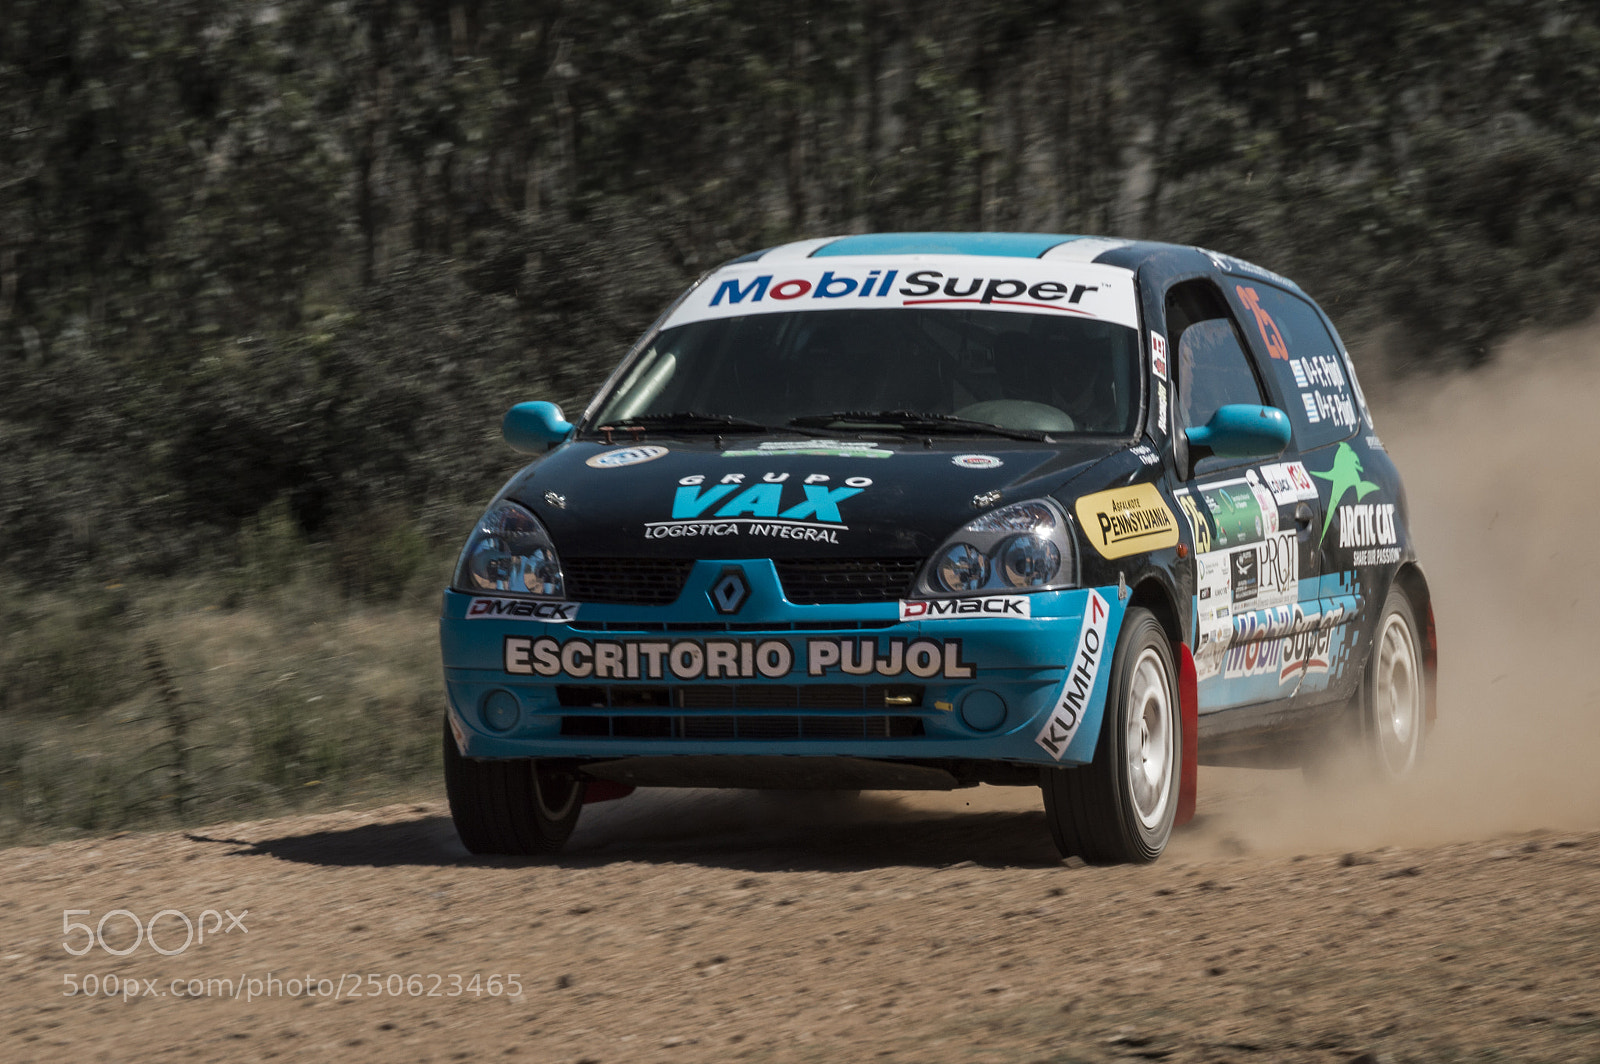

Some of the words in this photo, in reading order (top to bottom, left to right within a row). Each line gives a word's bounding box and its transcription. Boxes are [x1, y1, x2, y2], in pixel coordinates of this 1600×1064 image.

[1236, 285, 1289, 361] 25
[678, 472, 873, 487] GRUPO
[671, 483, 865, 523] VAX
[644, 522, 740, 540] LOGISTICA
[748, 523, 840, 545] INTEGRAL
[1096, 507, 1171, 546] PENNSYLVANIA
[1179, 495, 1211, 554] 25
[1339, 504, 1376, 548] ARCTIC
[1375, 503, 1397, 545] CAT
[1353, 551, 1367, 566] SHARE
[504, 636, 794, 681] ESCRITORIO
[807, 639, 977, 680] PUJOL
[1041, 628, 1099, 755] KUMHO
